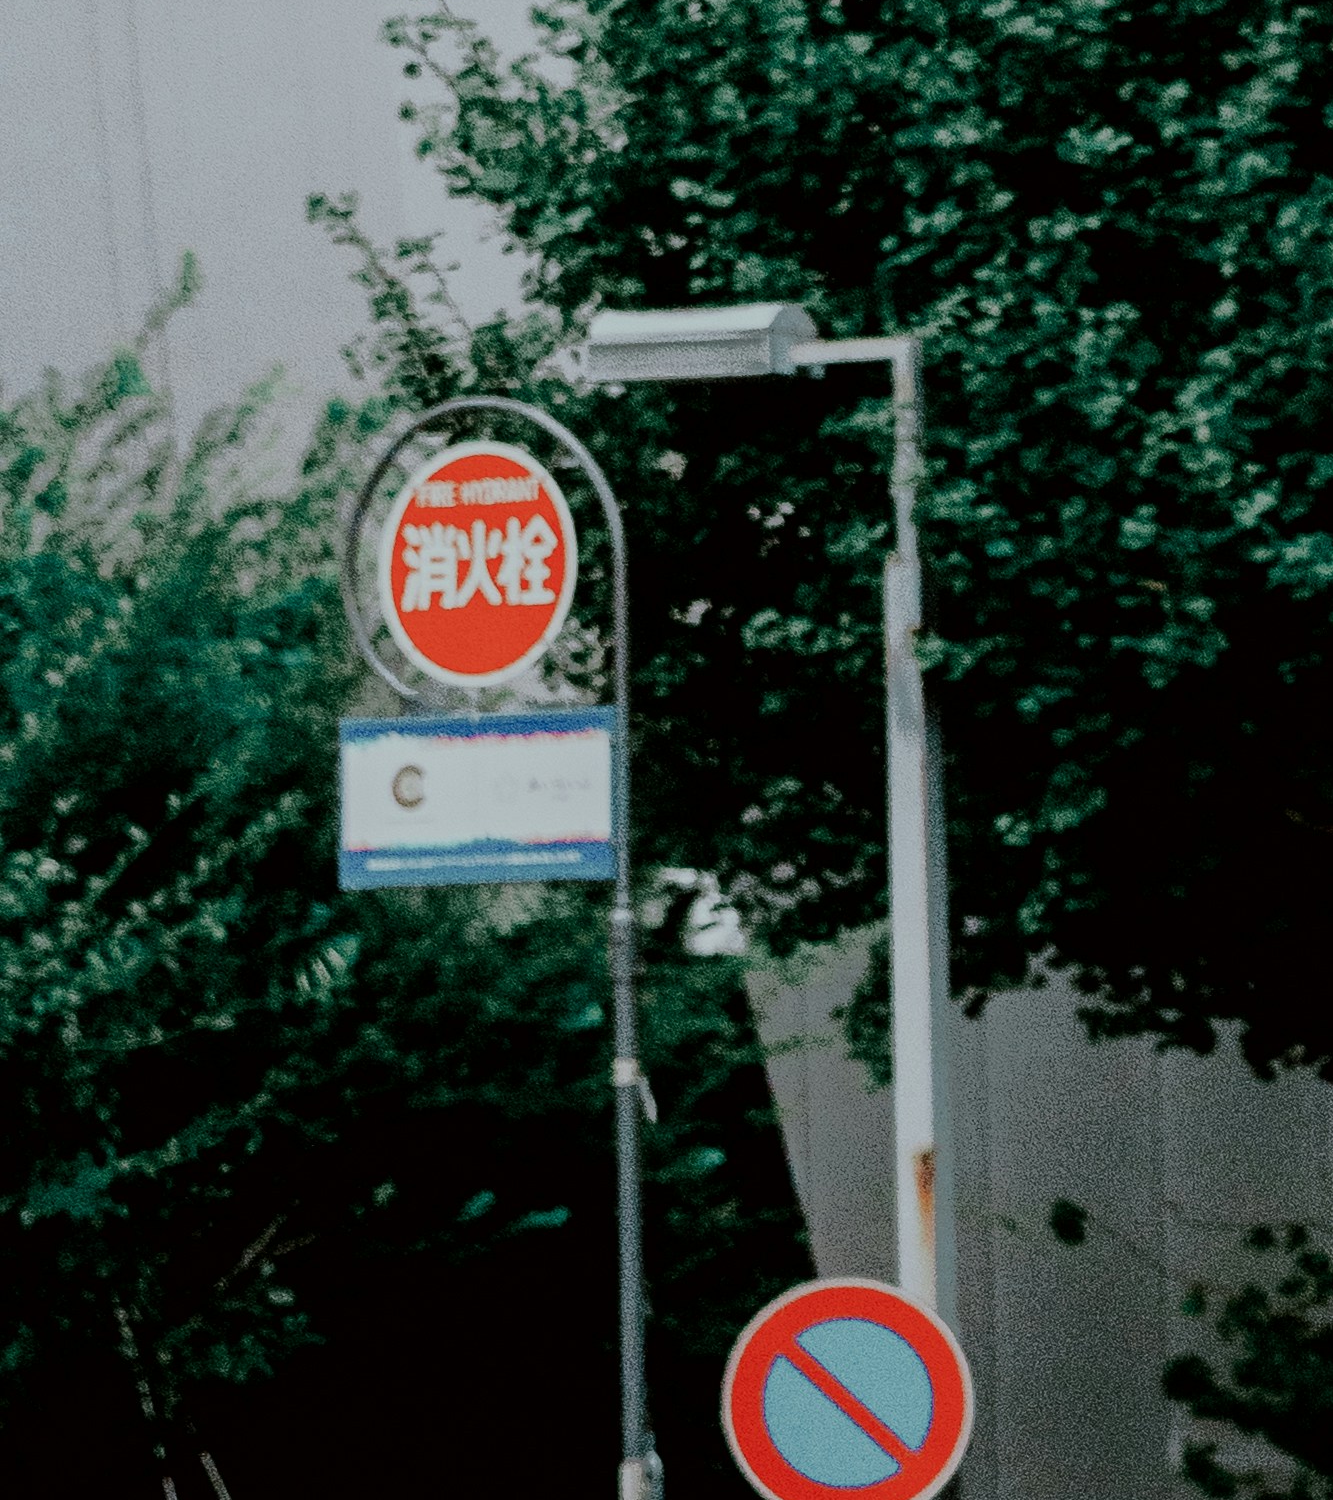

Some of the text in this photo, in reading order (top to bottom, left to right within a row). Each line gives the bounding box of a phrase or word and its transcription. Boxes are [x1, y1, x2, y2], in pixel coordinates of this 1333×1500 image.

[460, 475, 540, 506] HYDRANT
[401, 513, 559, 612] 消火栓
